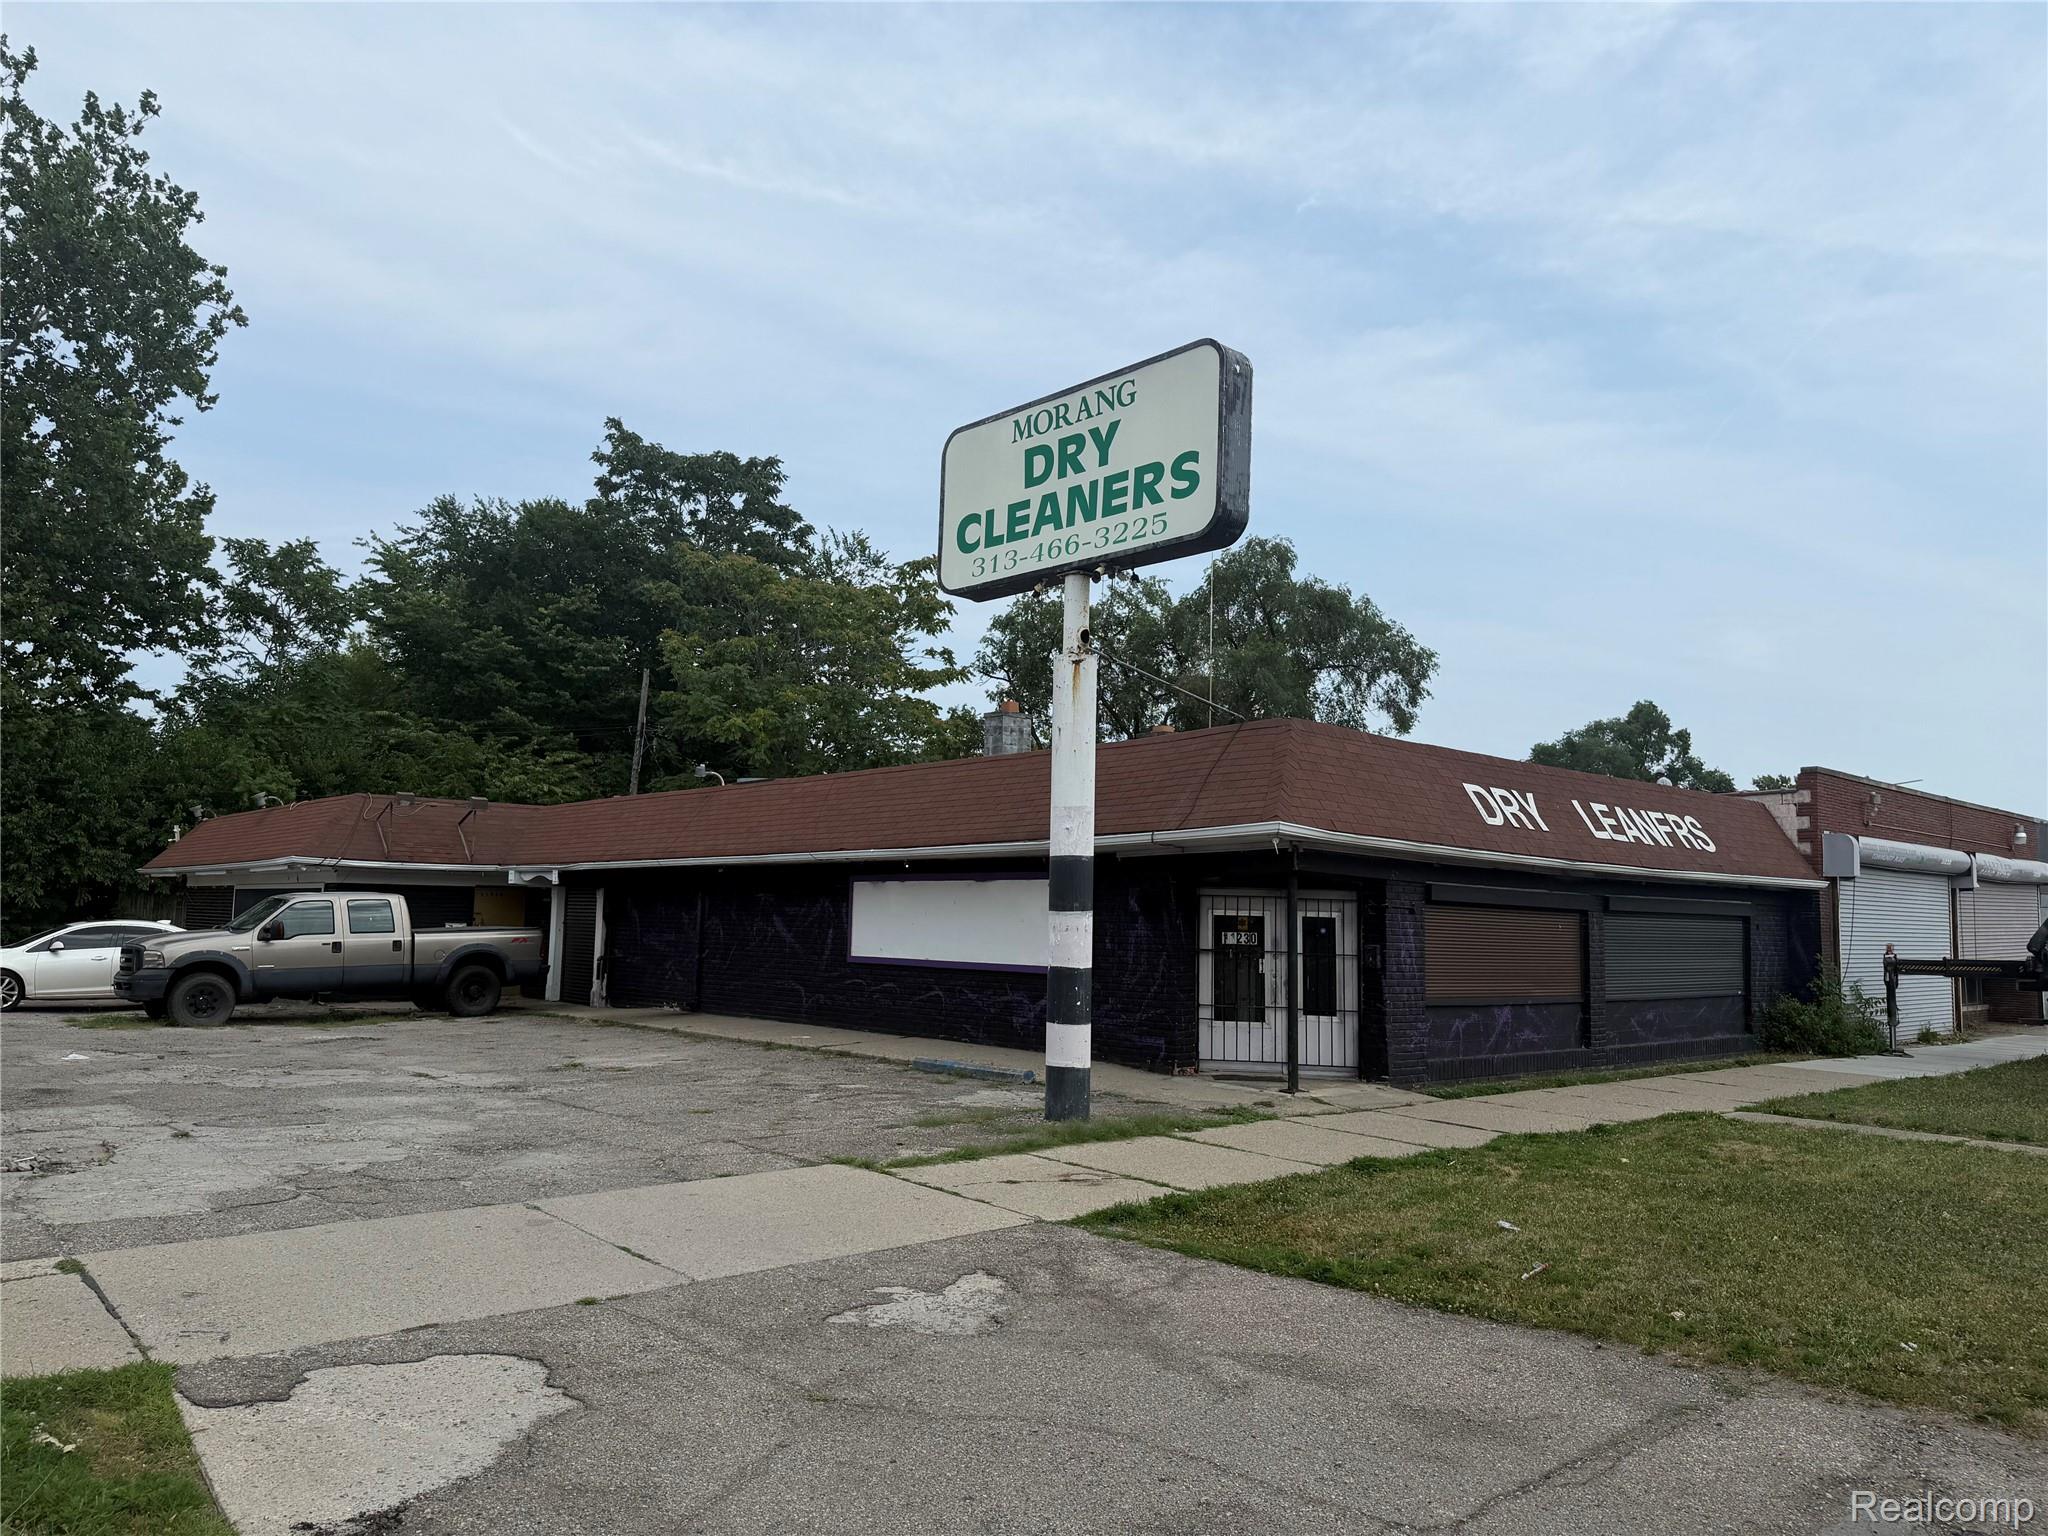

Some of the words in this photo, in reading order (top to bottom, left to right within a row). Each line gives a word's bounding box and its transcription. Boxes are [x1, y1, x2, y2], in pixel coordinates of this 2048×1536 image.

[1011, 379, 1137, 443] MORANG
[1024, 419, 1122, 489] DRY
[956, 450, 1201, 554] CLEANERS
[971, 512, 1168, 578] 313-466-3225
[1462, 782, 1550, 832] DRY
